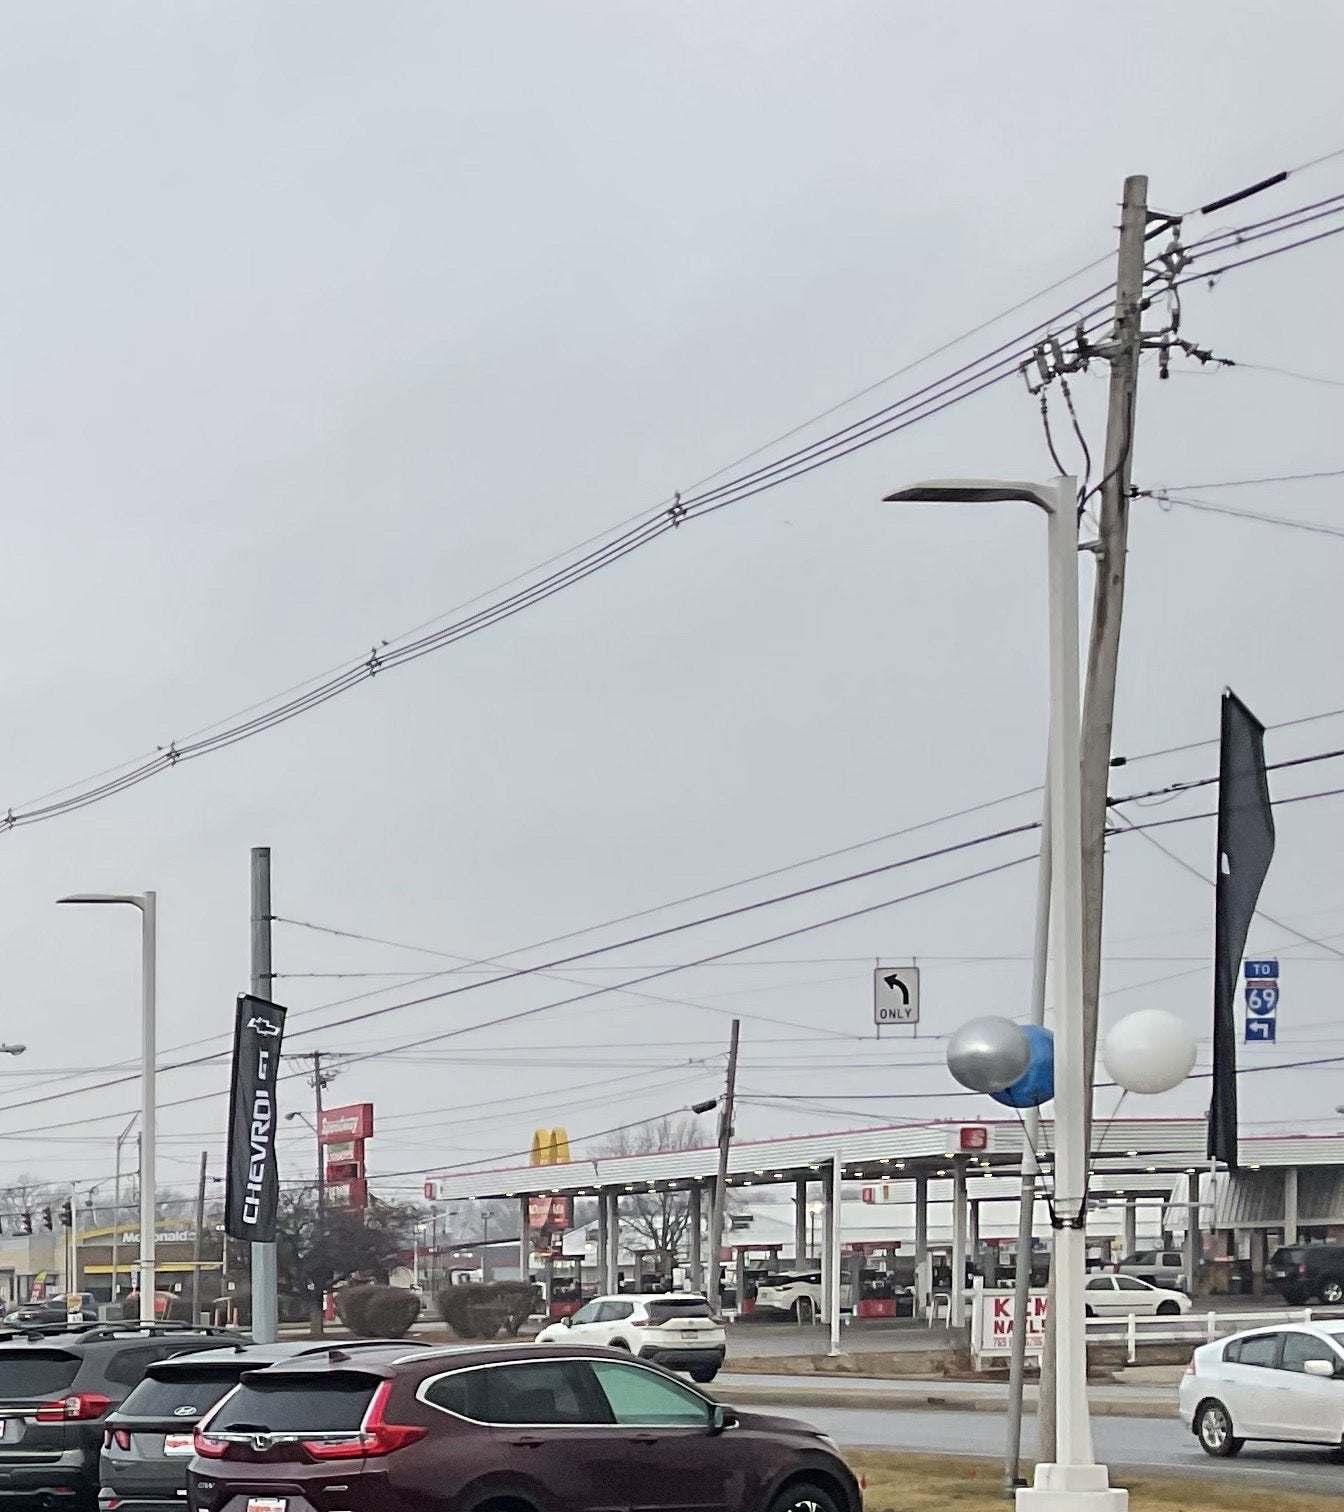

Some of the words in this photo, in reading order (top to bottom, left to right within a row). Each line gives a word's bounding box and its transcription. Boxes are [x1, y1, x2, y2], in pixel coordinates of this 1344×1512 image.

[1253, 964, 1271, 975] TO
[1249, 989, 1275, 1009] 69
[880, 1008, 912, 1019] ONLY
